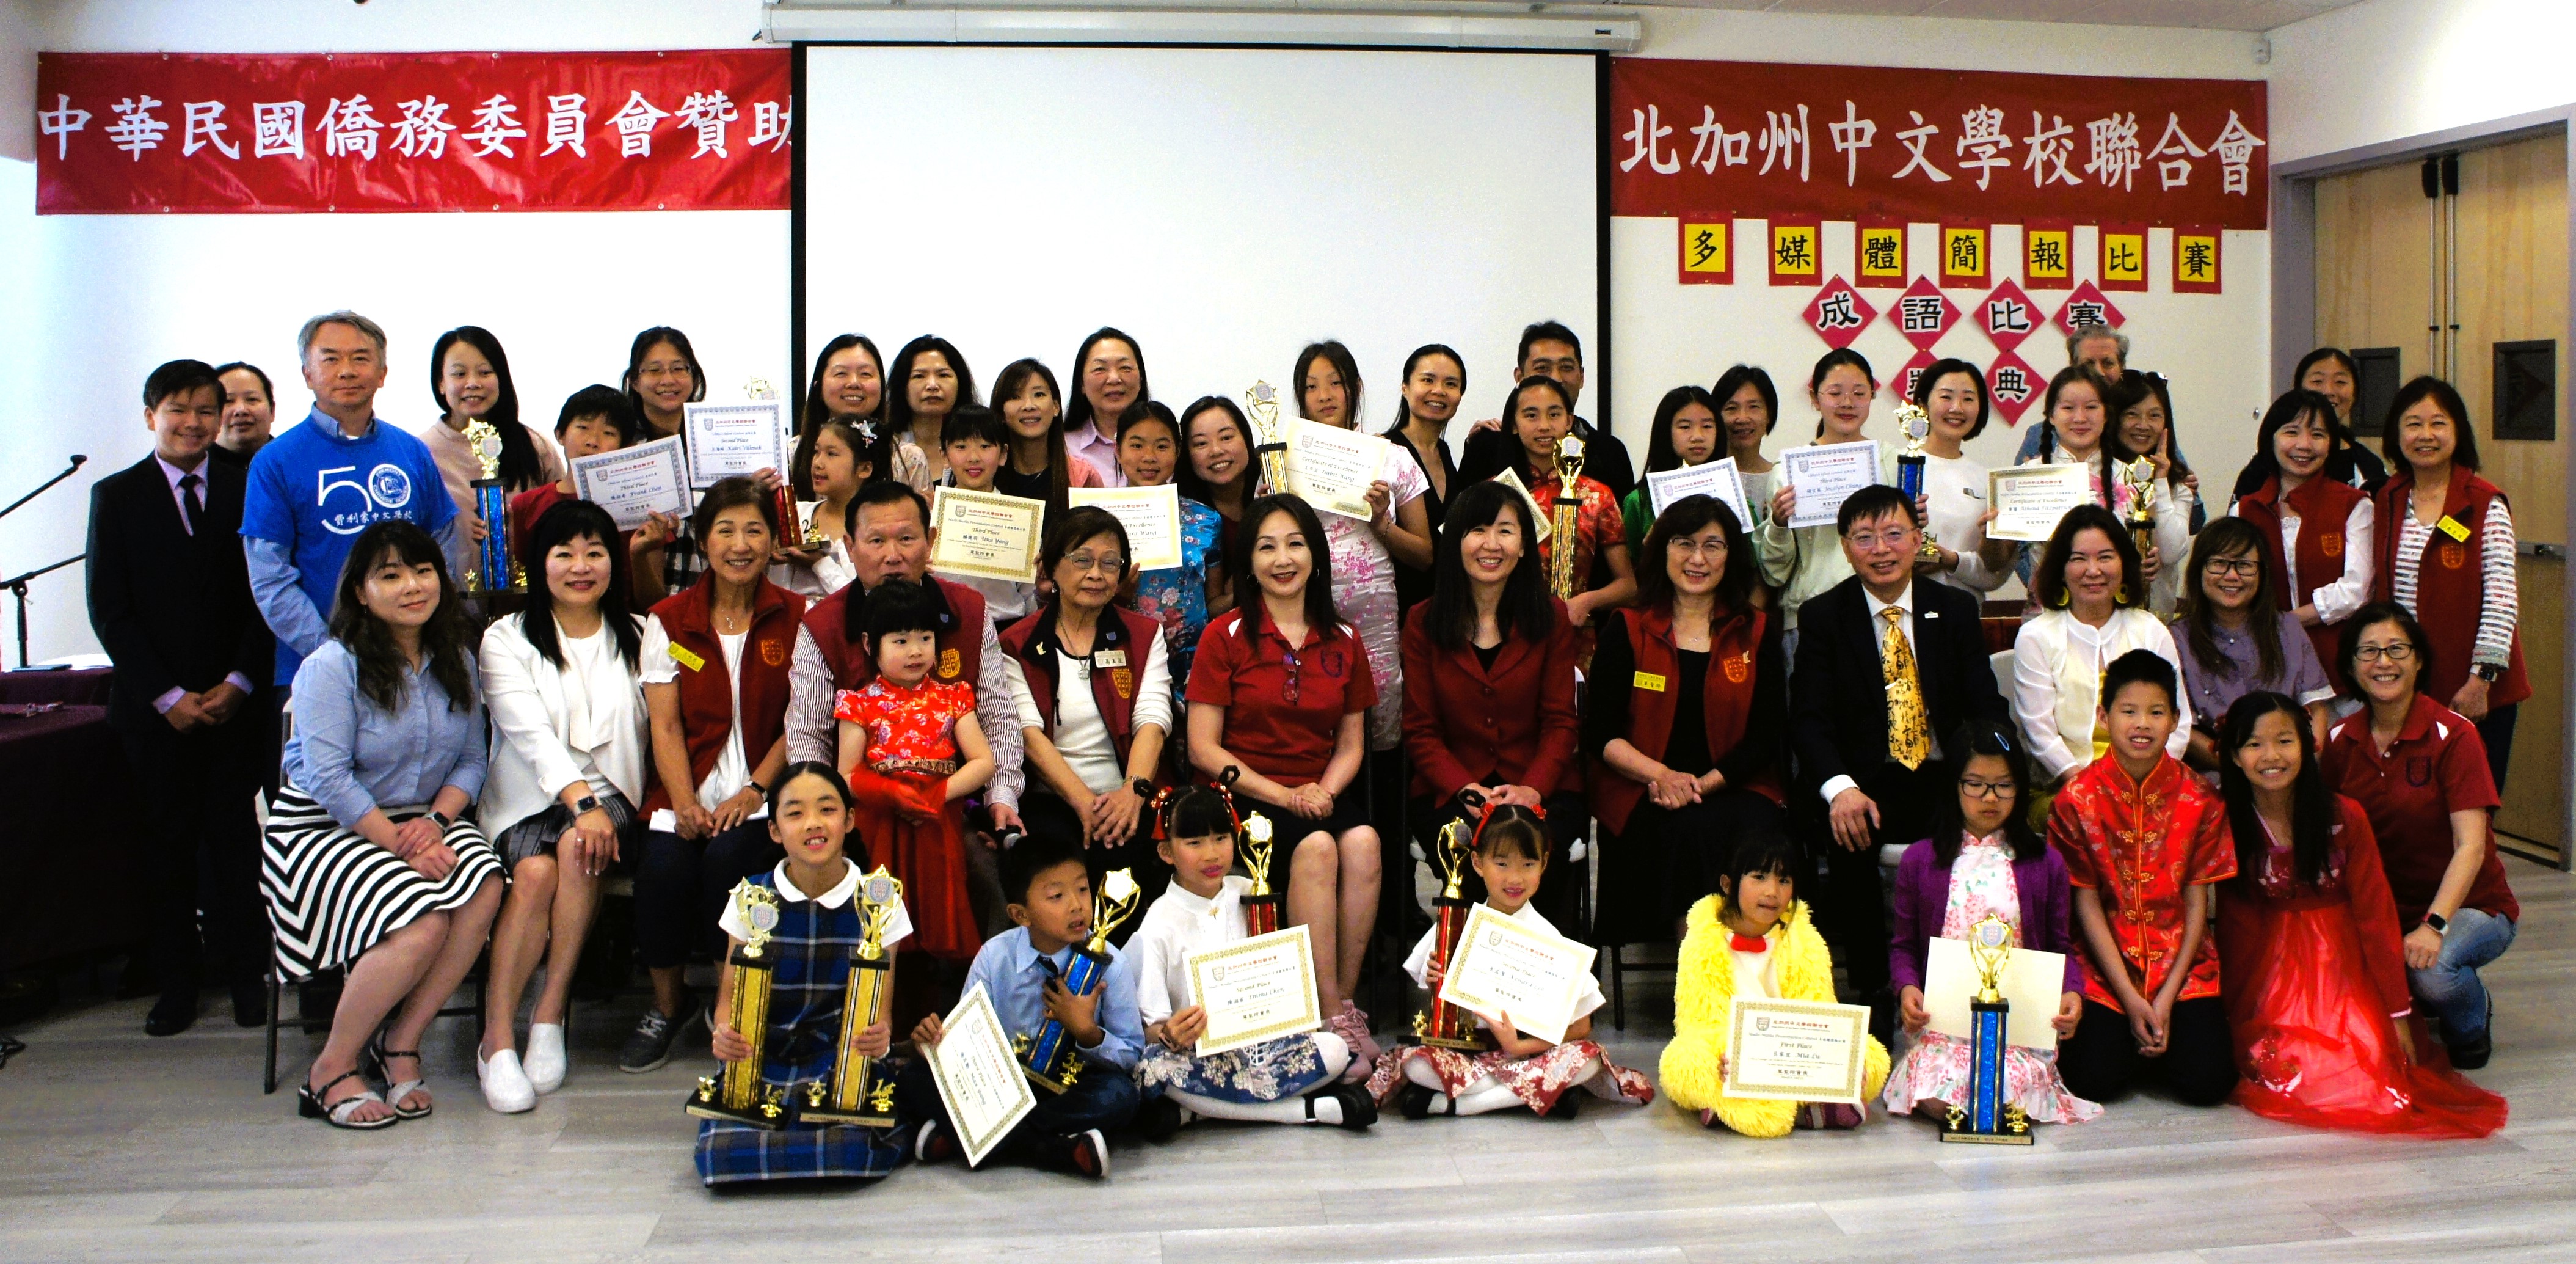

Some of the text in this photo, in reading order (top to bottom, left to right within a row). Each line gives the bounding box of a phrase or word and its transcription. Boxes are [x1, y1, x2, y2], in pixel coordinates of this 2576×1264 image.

[38, 90, 791, 161] 中華民國僑務委員會贊助
[1620, 100, 2265, 195] 北加州中文學校聯合會
[1690, 230, 2213, 277] 多媒體簡報比賽
[1817, 293, 2105, 329] 成語比賽
[318, 462, 412, 535] 50
